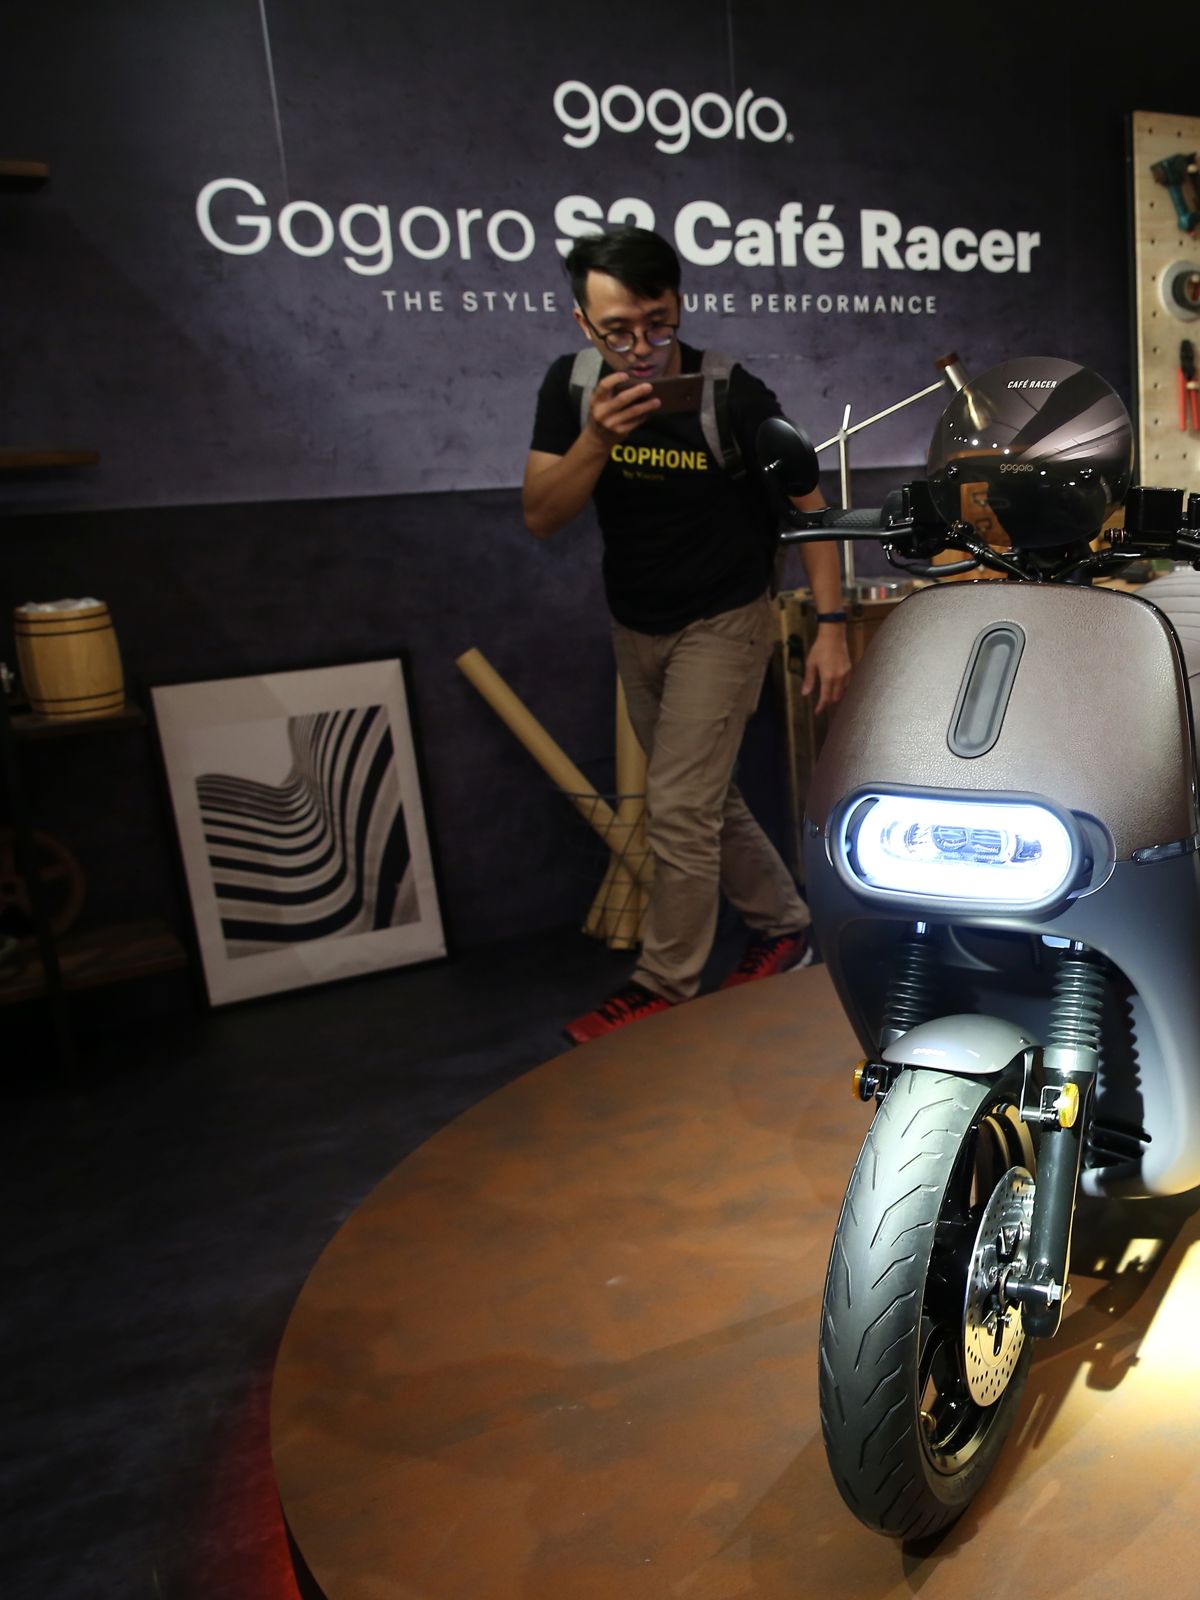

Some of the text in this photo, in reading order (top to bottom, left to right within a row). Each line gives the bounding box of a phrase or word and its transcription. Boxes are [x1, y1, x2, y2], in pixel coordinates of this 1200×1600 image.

[554, 81, 788, 154] gogoro
[197, 178, 536, 276] Gogoro
[674, 200, 845, 269] Café
[860, 209, 1041, 273] Racer
[382, 290, 444, 312] THE
[462, 291, 557, 312] STYLE
[683, 293, 736, 313] URE
[750, 293, 937, 314] PERFORMANCE
[1007, 379, 1058, 389] CAFÉ RACER
[611, 444, 708, 470] COPHONE
[999, 463, 1034, 474] gogoro
